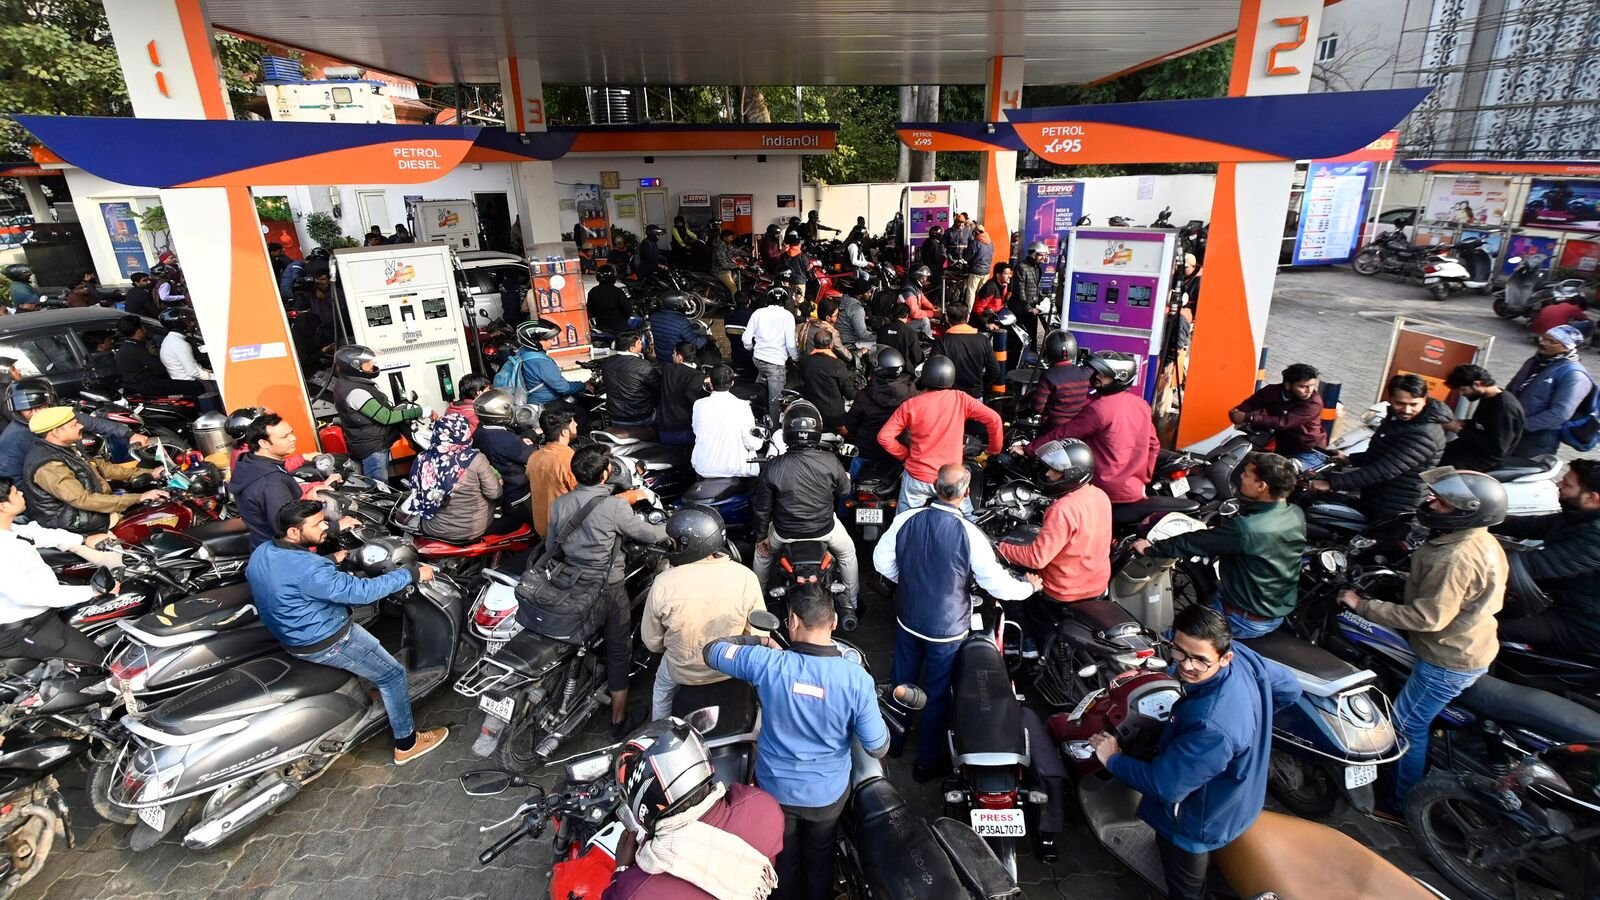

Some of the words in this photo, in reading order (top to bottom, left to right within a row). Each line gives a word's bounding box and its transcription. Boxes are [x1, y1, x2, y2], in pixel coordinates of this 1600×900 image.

[1265, 15, 1309, 76] 2
[1003, 90, 1019, 109] 4
[527, 98, 544, 124] 3
[1042, 126, 1086, 136] PETROL
[762, 135, 818, 146] IndianOil
[393, 148, 442, 158] PETROL
[398, 160, 441, 170] DIESEL
[1046, 185, 1073, 193] SERVO
[980, 813, 1014, 822] PRESS
[974, 825, 1024, 835] UP35AL7073
